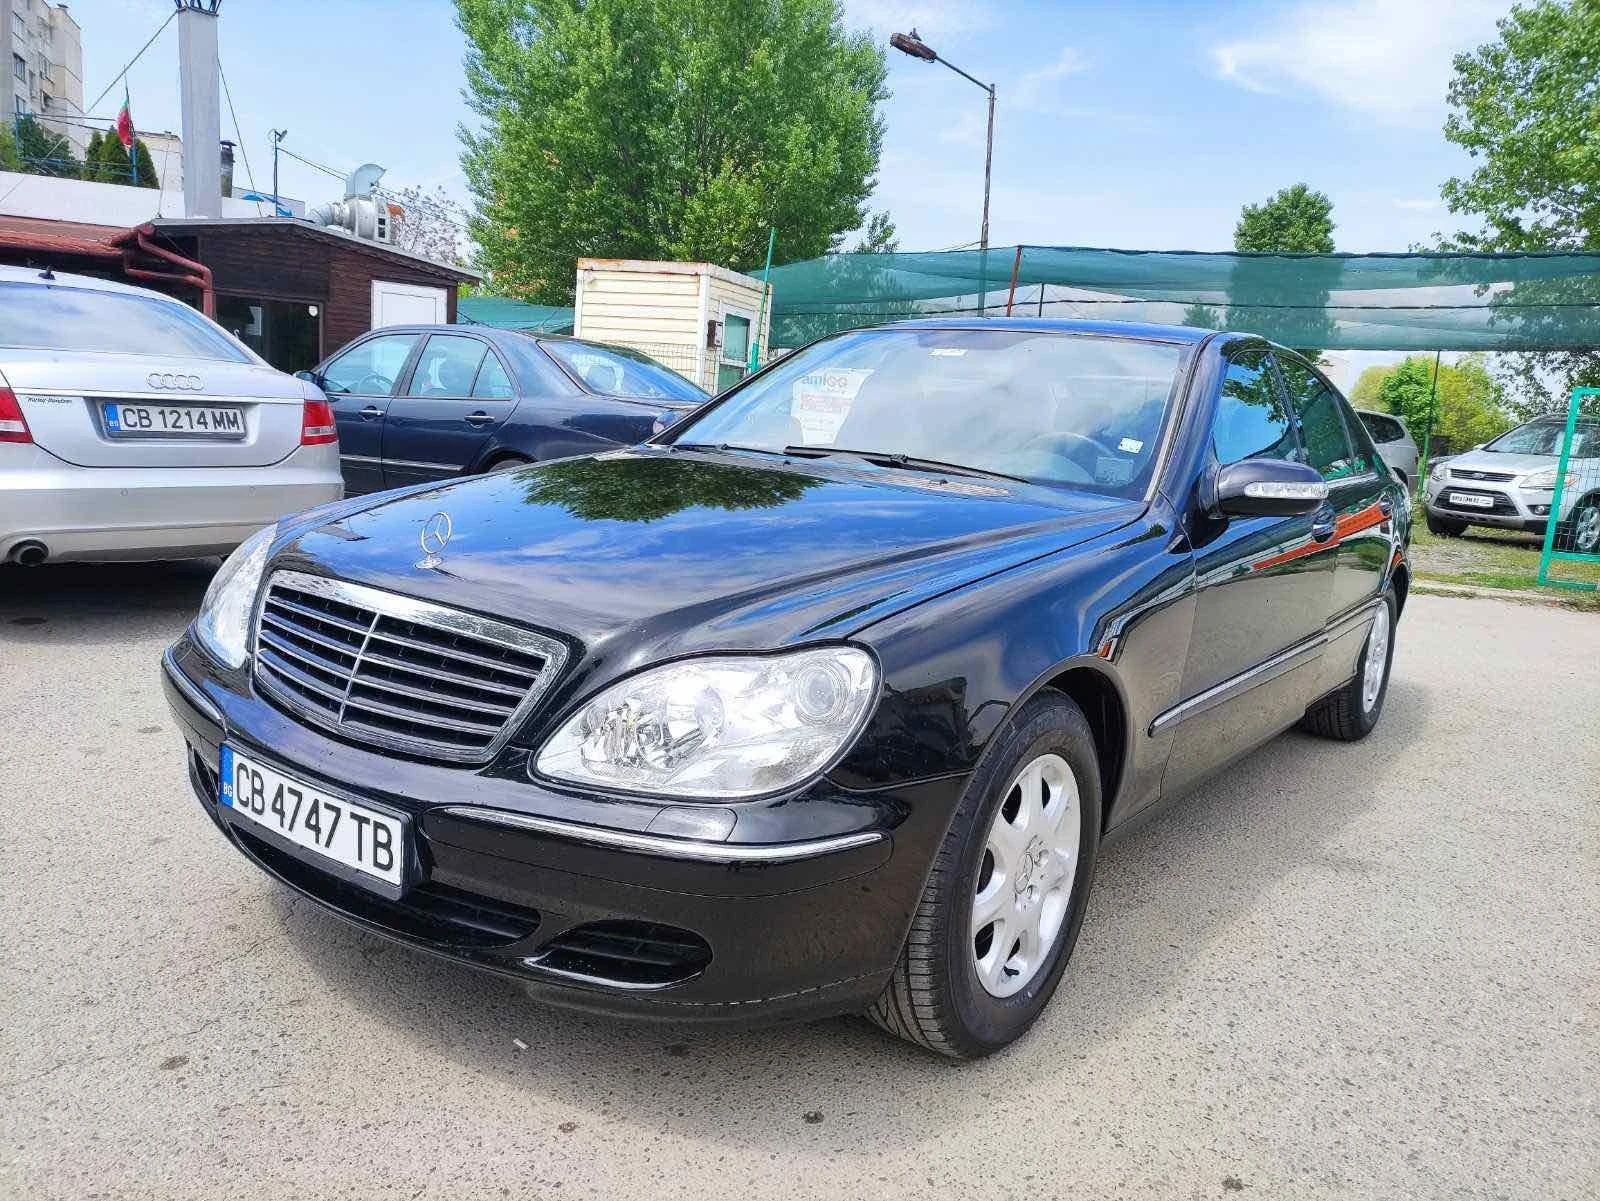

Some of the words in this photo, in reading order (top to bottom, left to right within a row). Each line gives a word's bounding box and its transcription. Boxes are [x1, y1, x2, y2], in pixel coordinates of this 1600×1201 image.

[122, 408, 152, 428] CB
[159, 409, 208, 429] 1214
[211, 410, 240, 430] MM
[223, 782, 233, 797] BG
[236, 762, 265, 816] CB
[272, 783, 342, 848] 4747
[350, 812, 393, 871] TB
